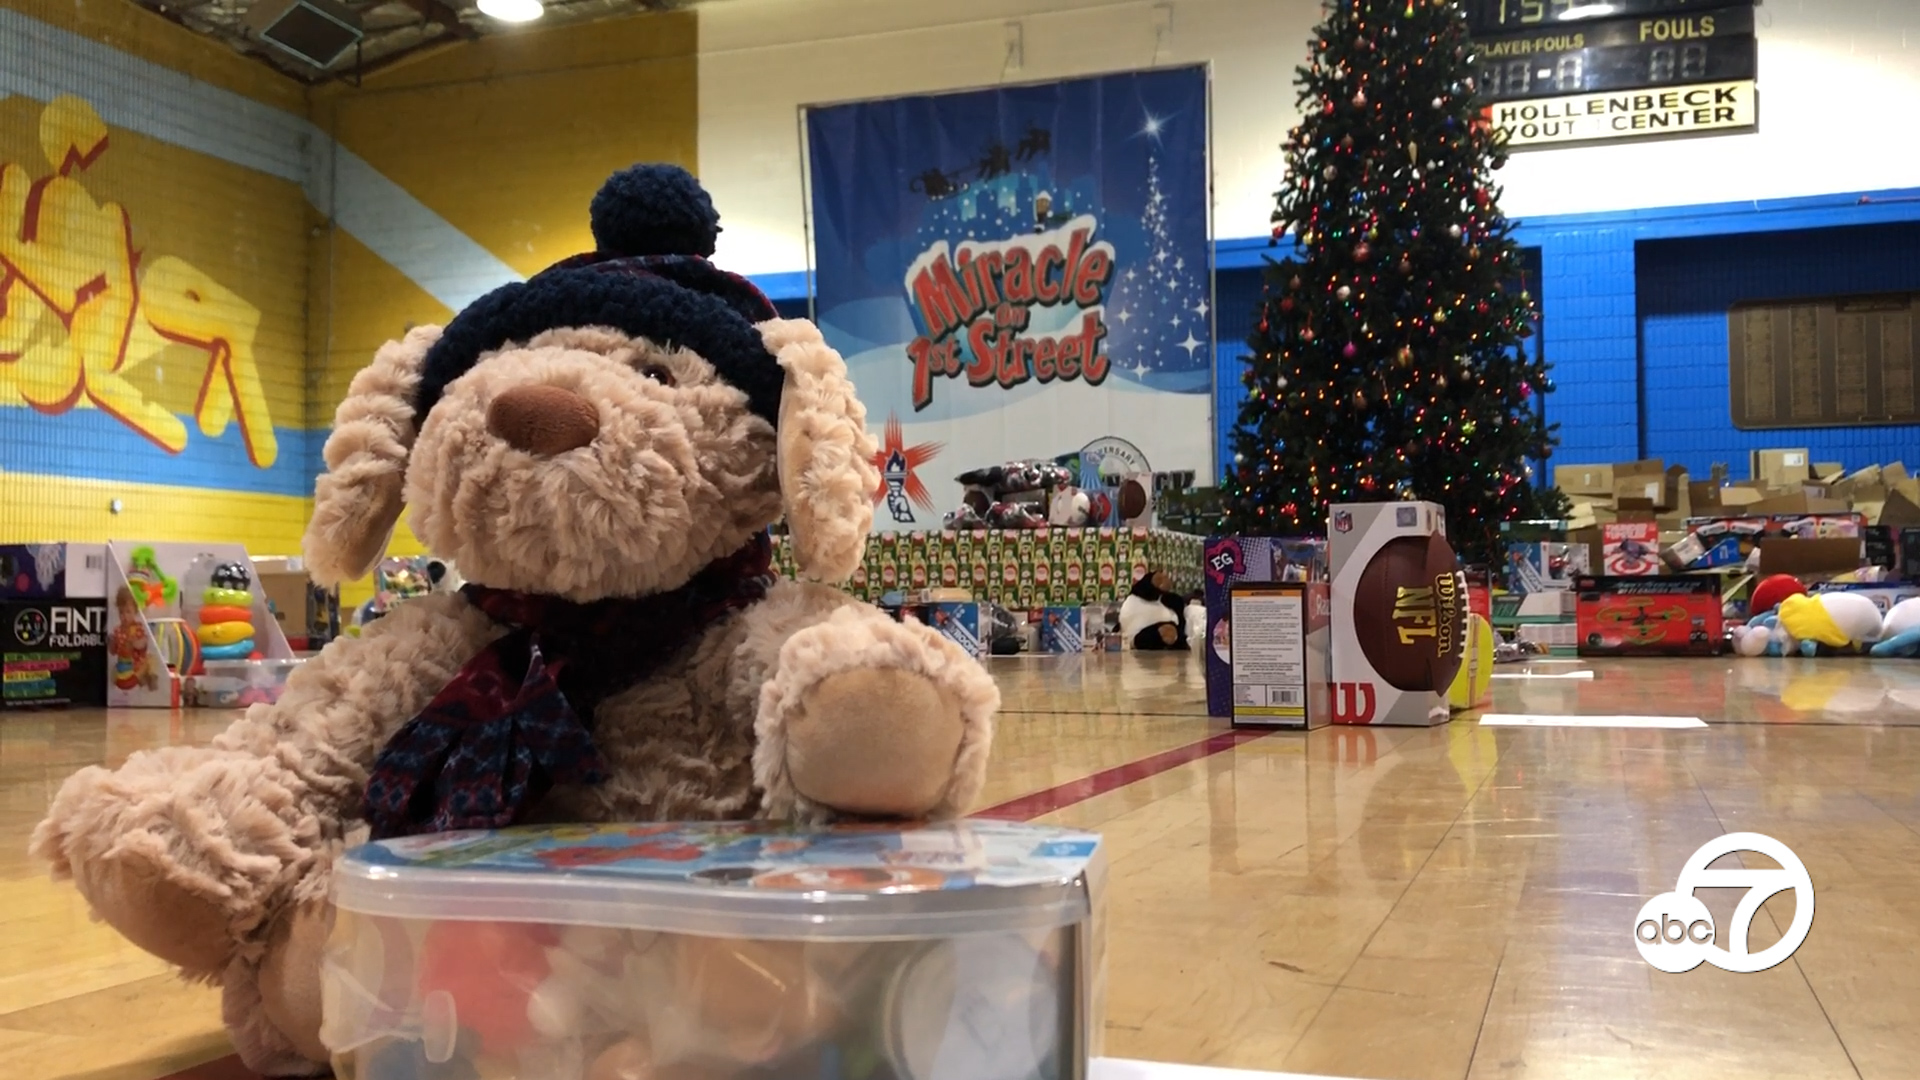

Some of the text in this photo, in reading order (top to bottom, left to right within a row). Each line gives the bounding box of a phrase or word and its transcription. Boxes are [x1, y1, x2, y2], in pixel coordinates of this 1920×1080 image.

[1639, 17, 1715, 42] FOULS
[1500, 86, 1738, 122] HOLLENBECK
[1501, 107, 1736, 140] YOUT CENTER
[912, 227, 1110, 338] Miracle
[906, 310, 1110, 409] 1st Street
[1210, 553, 1234, 571] EG
[50, 606, 107, 634] FINT
[1392, 586, 1437, 645] NFL
[1435, 572, 1457, 658] Wilson
[48, 633, 105, 648] FOLDABL
